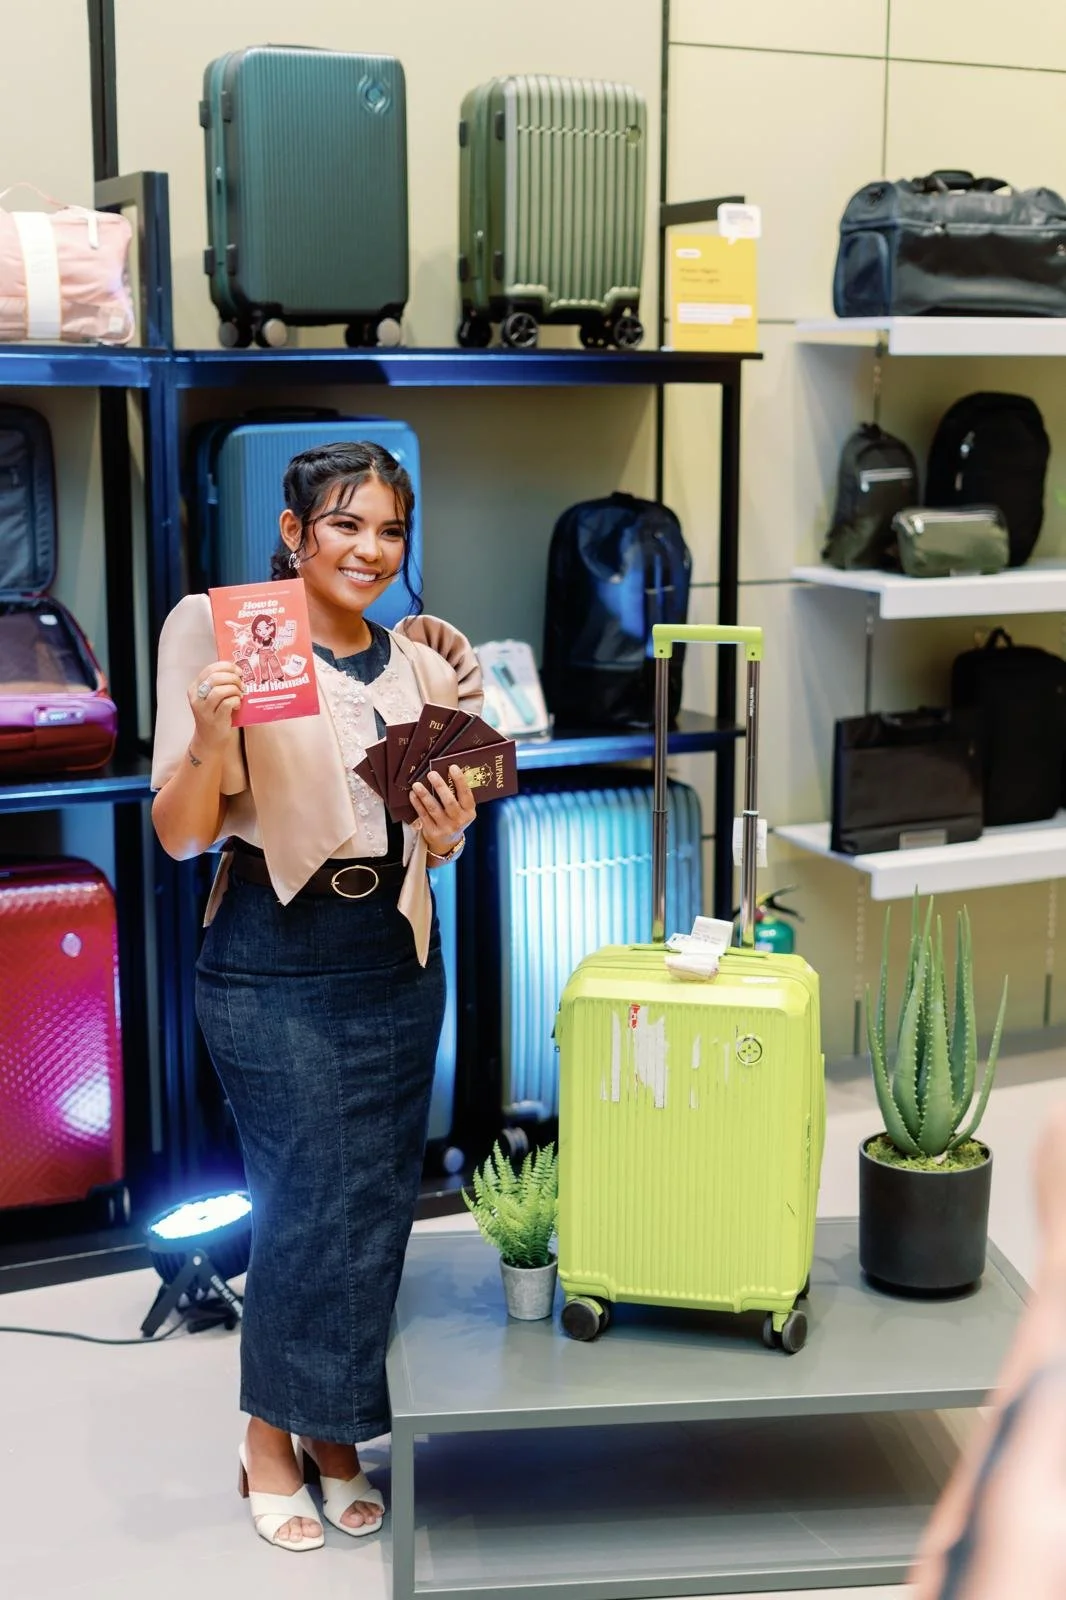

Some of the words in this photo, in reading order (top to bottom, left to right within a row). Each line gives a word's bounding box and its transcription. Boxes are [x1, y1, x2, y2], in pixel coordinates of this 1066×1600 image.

[243, 601, 267, 610] How
[268, 600, 278, 608] to
[238, 608, 277, 619] Become
[495, 754, 504, 789] PILIPINAS
